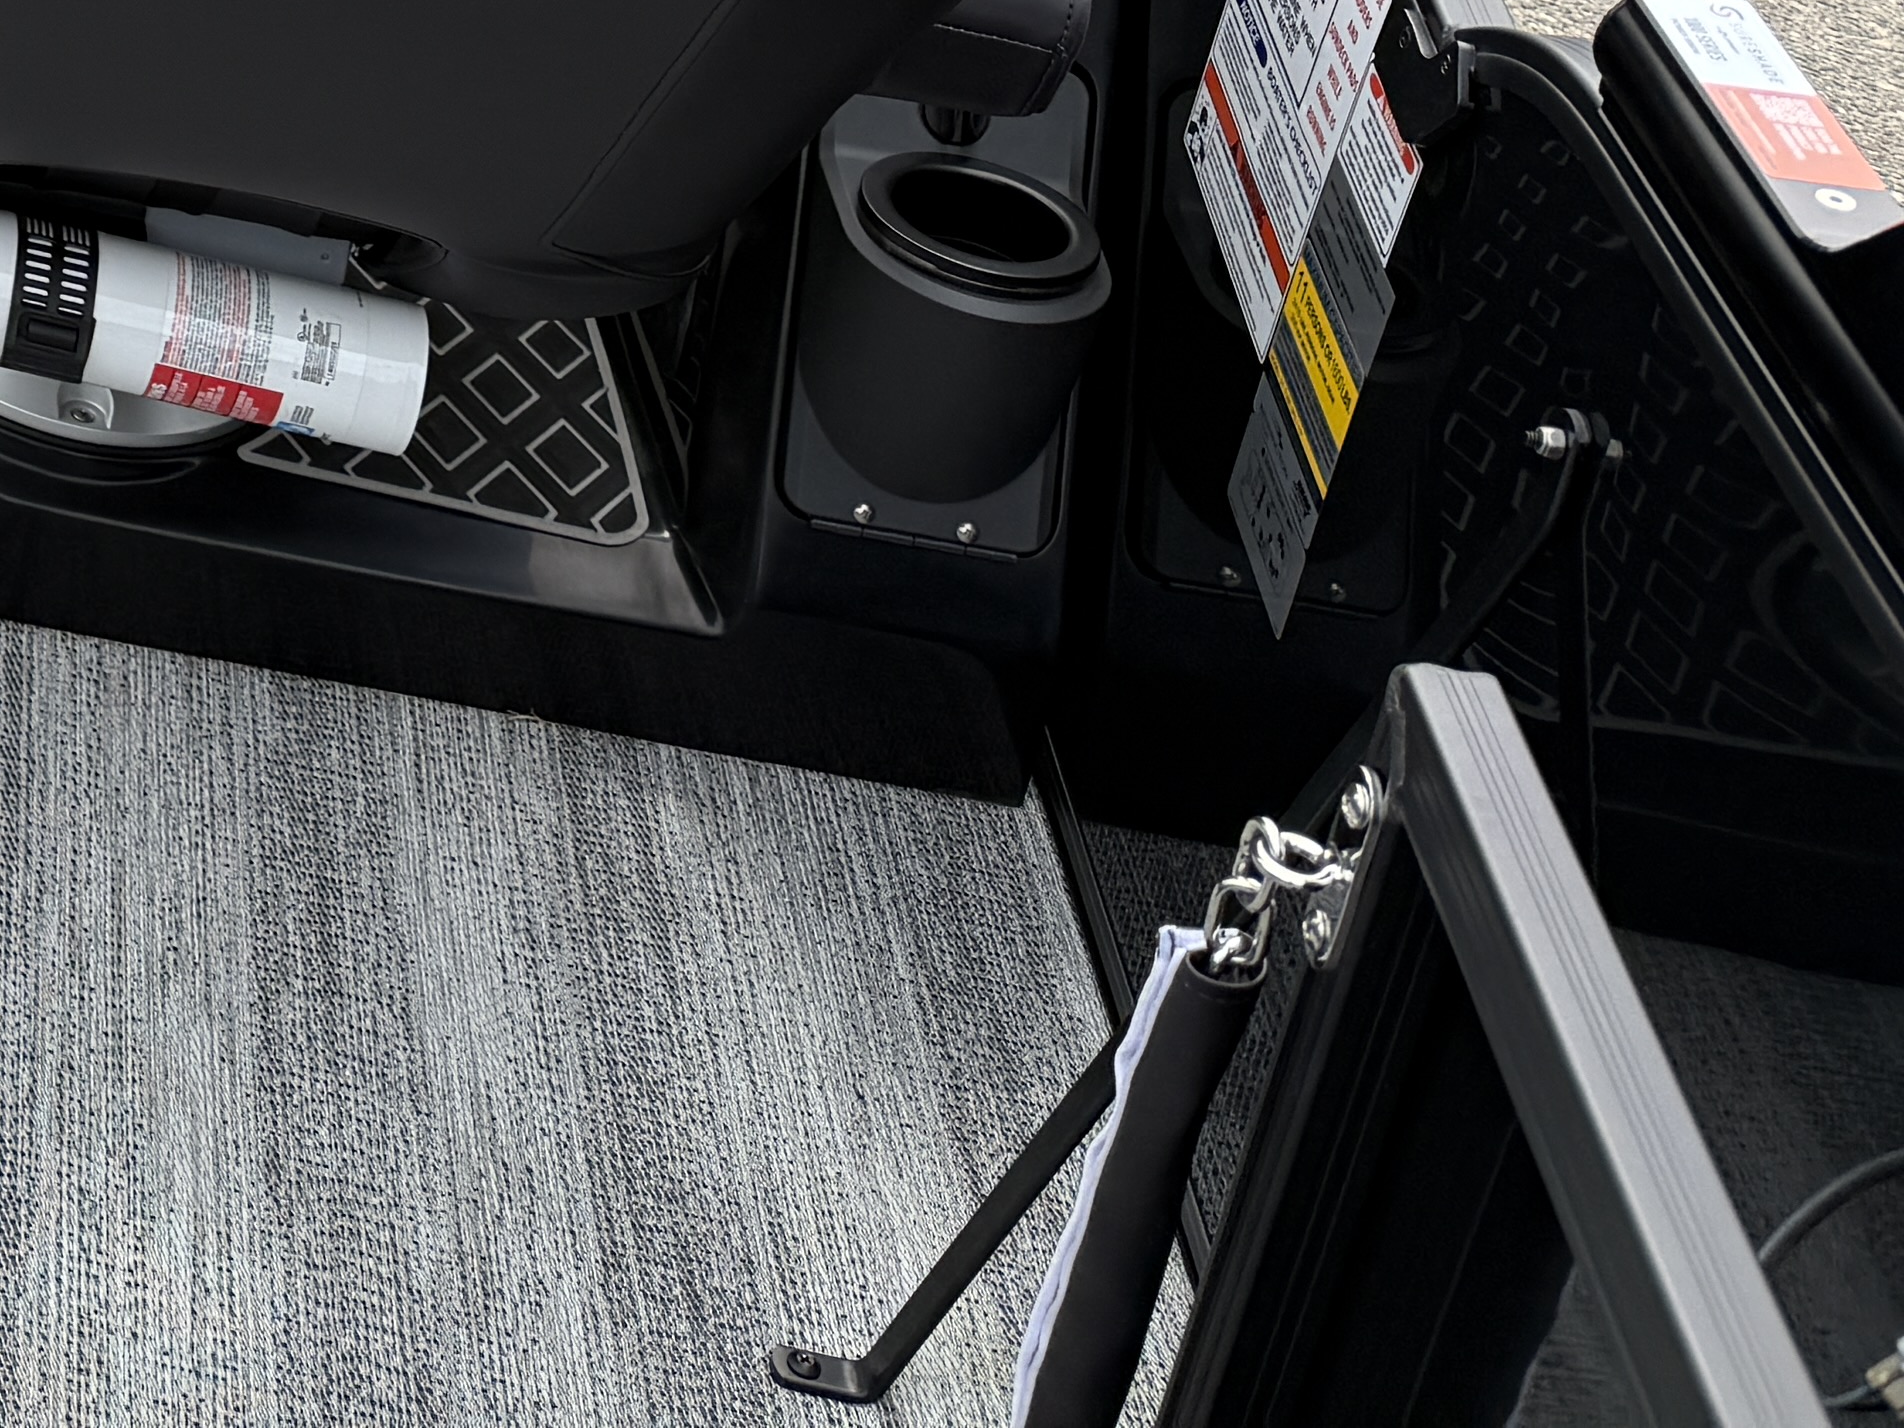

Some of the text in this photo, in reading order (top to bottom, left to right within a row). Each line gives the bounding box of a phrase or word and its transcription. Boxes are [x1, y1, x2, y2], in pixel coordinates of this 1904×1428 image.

[1240, 0, 1259, 44] NOTICE
[1276, 11, 1294, 56] WATER
[1300, 15, 1316, 57] WHEN
[1295, 271, 1308, 303] 11
